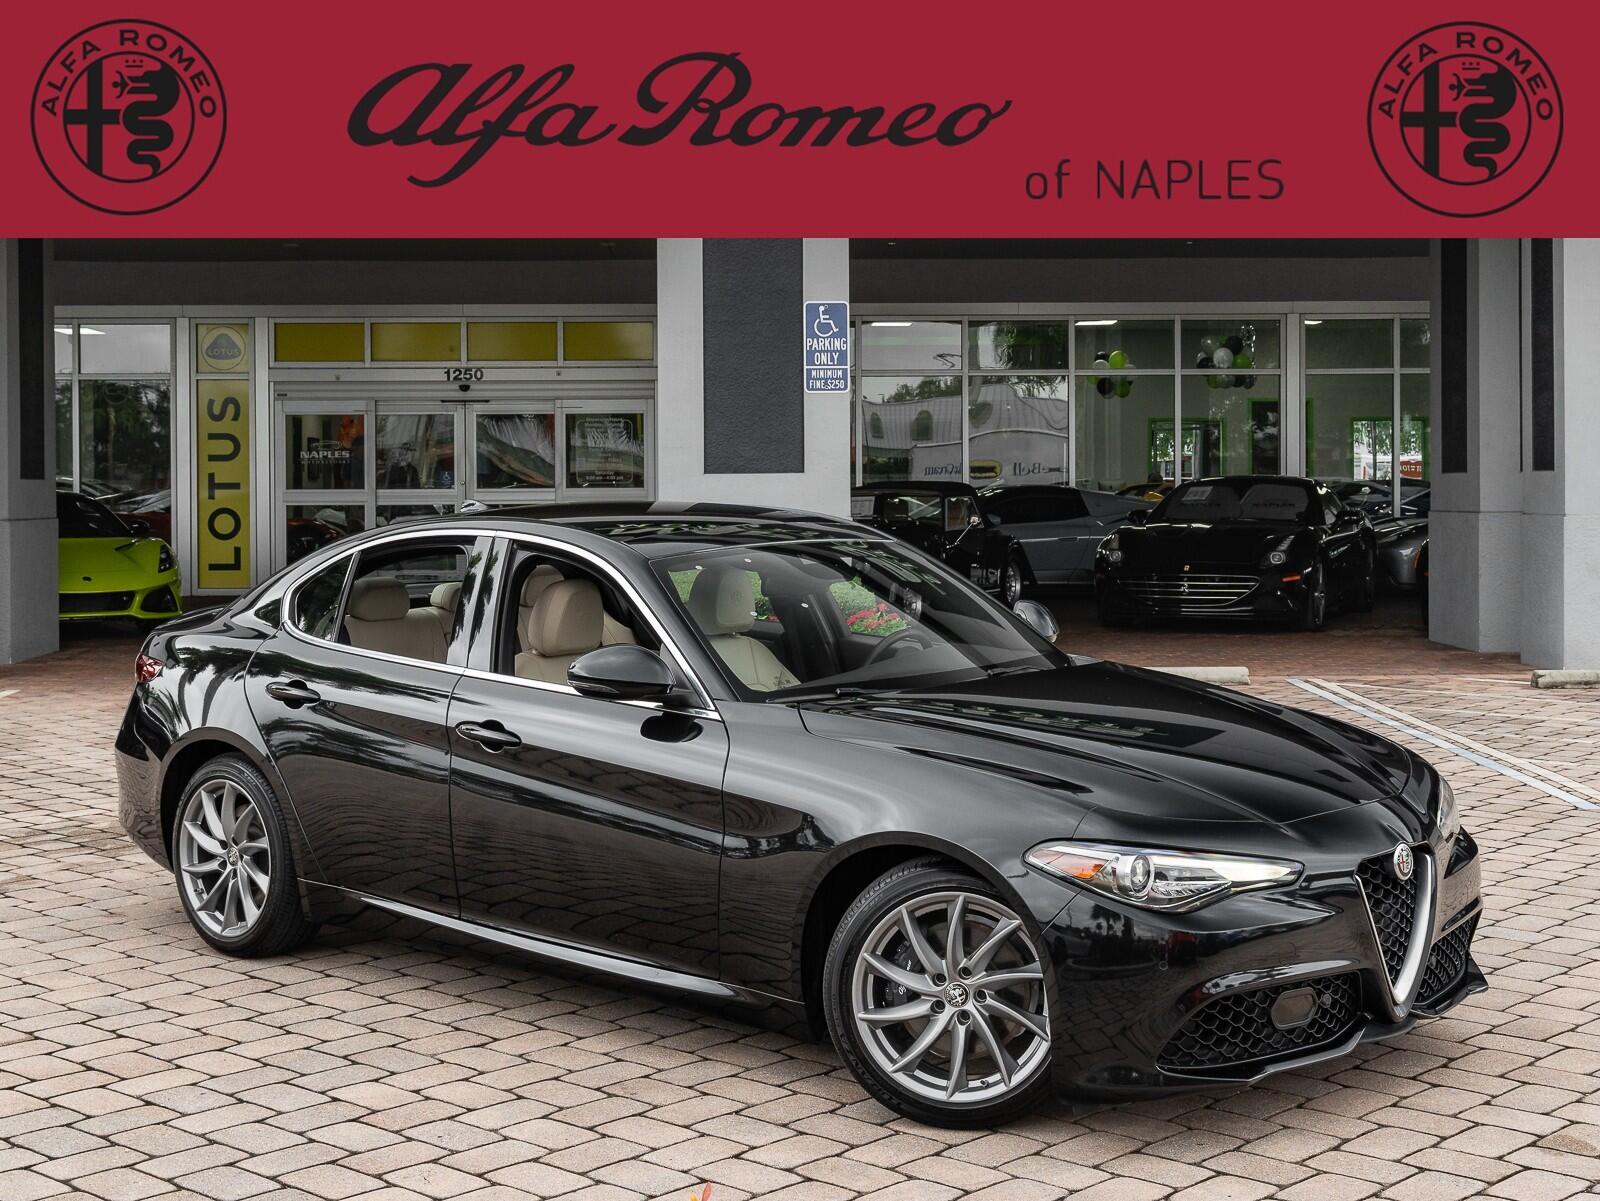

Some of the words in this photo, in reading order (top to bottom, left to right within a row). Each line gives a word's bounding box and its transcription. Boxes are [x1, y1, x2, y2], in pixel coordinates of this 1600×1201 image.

[806, 338, 847, 351] PARKING
[208, 348, 241, 356] LOTUS
[814, 352, 840, 365] ONLY
[444, 368, 484, 381] 1250
[811, 369, 843, 379] MINIMUM
[809, 380, 825, 389] FINE
[827, 379, 845, 389] $250
[300, 450, 351, 459] NAPLES
[207, 396, 242, 571] LOTUS
